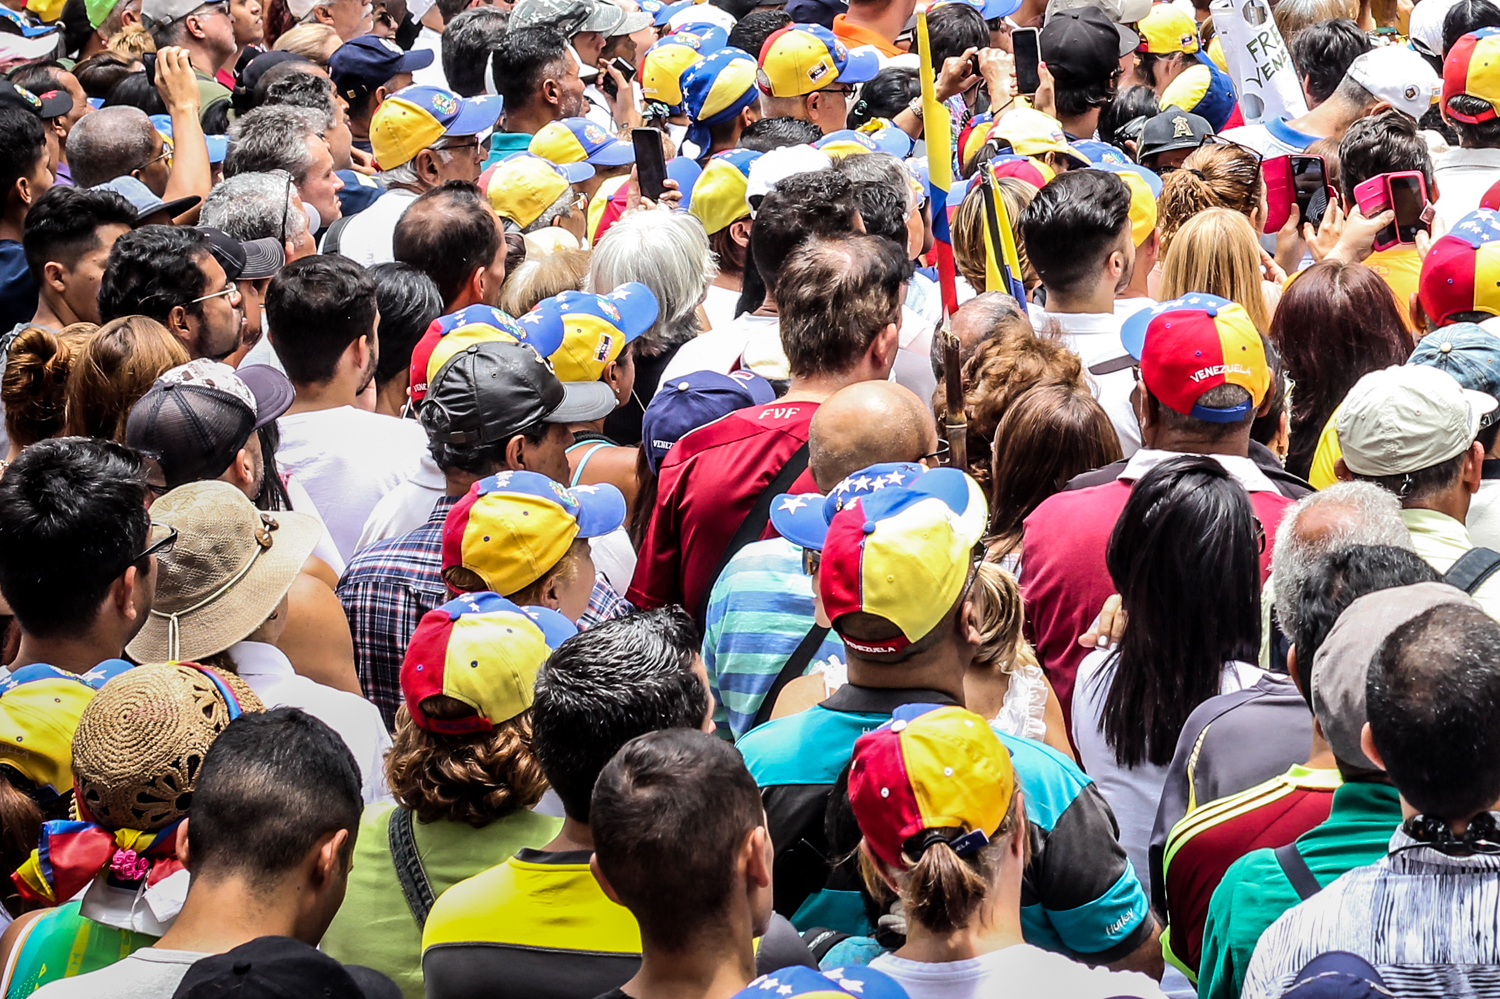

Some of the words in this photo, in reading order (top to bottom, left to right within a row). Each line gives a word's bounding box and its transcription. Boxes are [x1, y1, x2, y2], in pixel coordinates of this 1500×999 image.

[1172, 116, 1195, 139] A
[1190, 363, 1252, 384] VENEZUELA
[758, 407, 801, 420] FVF
[1106, 907, 1135, 935] Hurley
